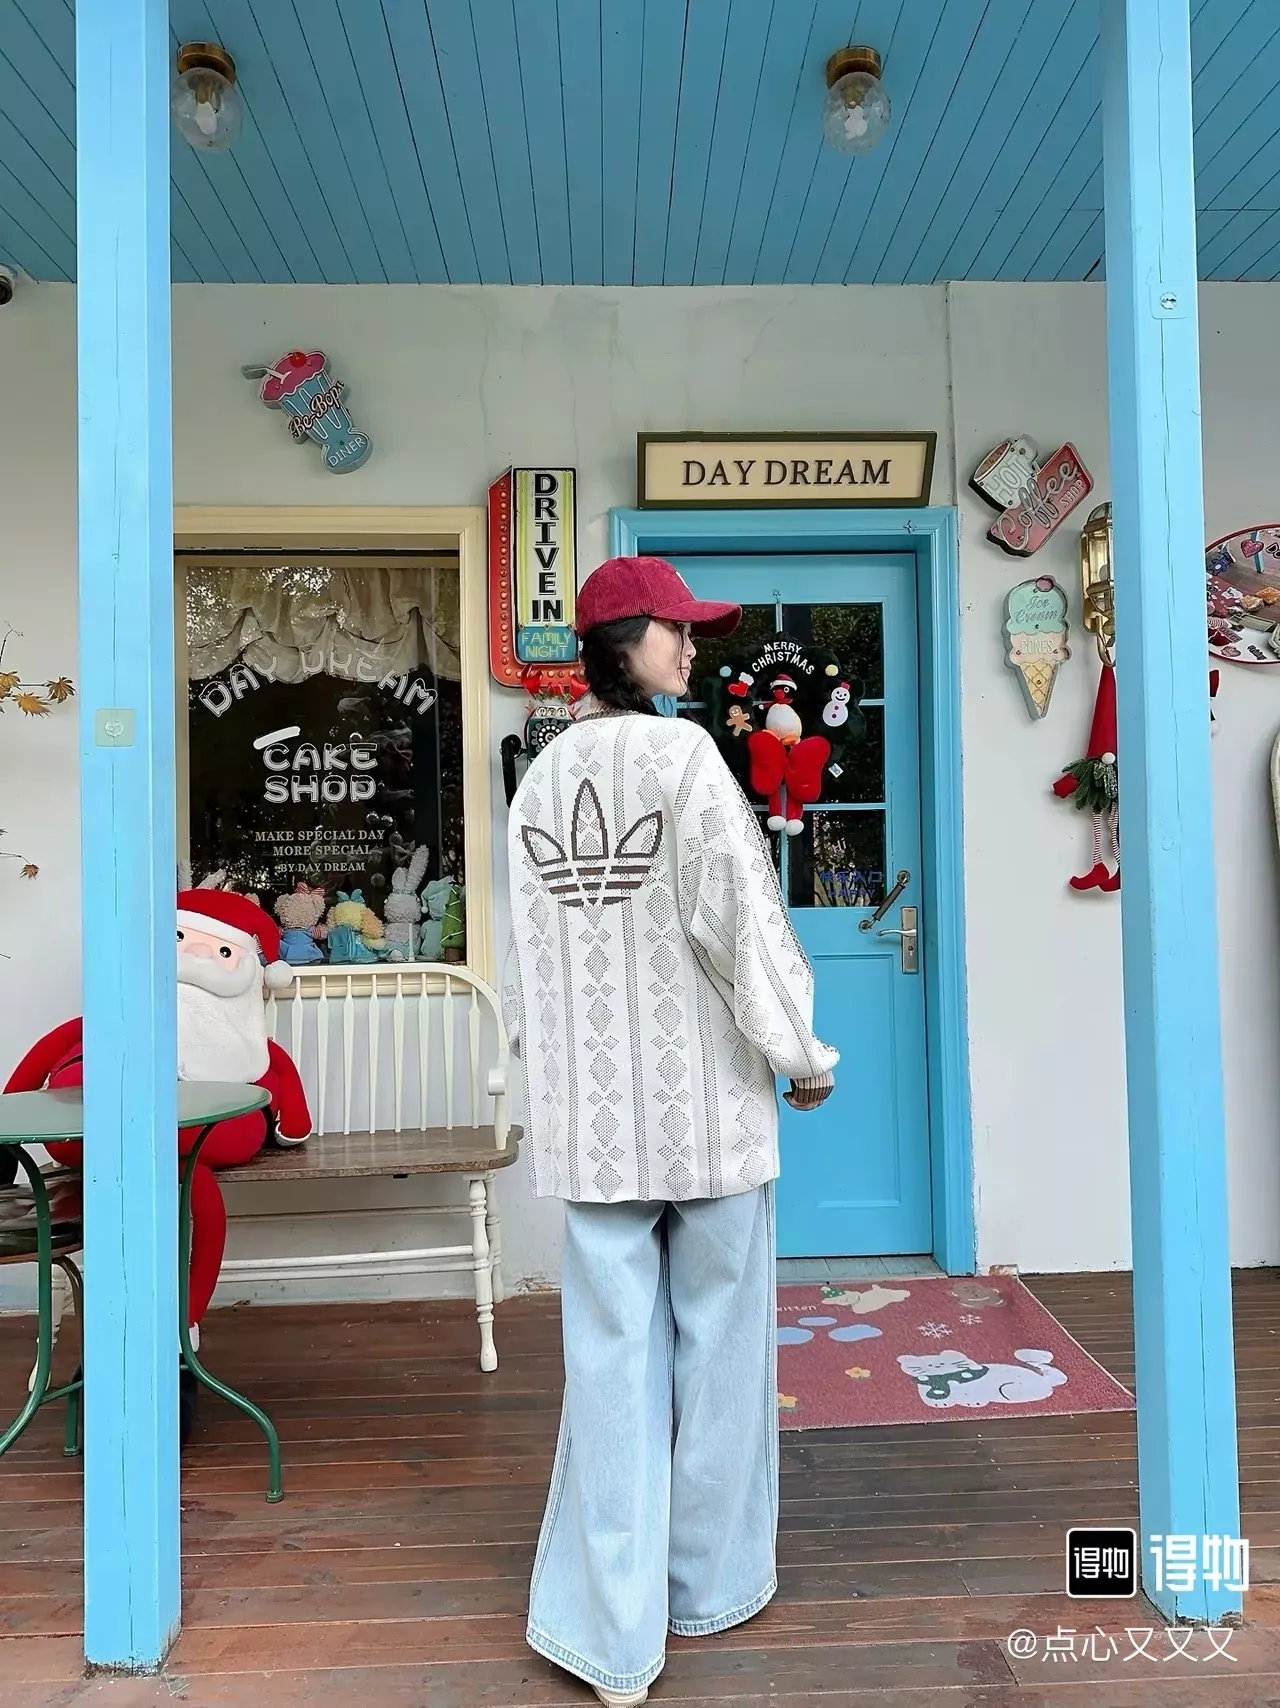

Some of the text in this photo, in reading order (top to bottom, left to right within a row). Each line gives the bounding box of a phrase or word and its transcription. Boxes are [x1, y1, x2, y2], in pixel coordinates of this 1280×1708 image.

[328, 437, 366, 467] DINER
[682, 458, 893, 487] DAY DREAM
[984, 453, 1033, 506] HOT
[1060, 478, 1086, 509] SHOP
[1000, 462, 1083, 550] Coffee
[531, 473, 564, 623] DRIVE IN
[1025, 595, 1050, 611] Ice
[1013, 608, 1059, 625] Cream
[521, 632, 573, 646] FAMILY
[763, 641, 803, 654] MERRY
[1021, 639, 1054, 655] CONES
[525, 645, 569, 659] NIGHT
[751, 651, 815, 675] CHRISTMAS
[199, 646, 439, 718] DAY DREAM
[263, 742, 379, 772] CAKE
[263, 774, 377, 804] SHOP
[254, 829, 386, 842] MAKE SPECIAL DAY
[273, 844, 372, 857] MORE SPECIAL
[280, 862, 366, 873] BY DAY DREAM
